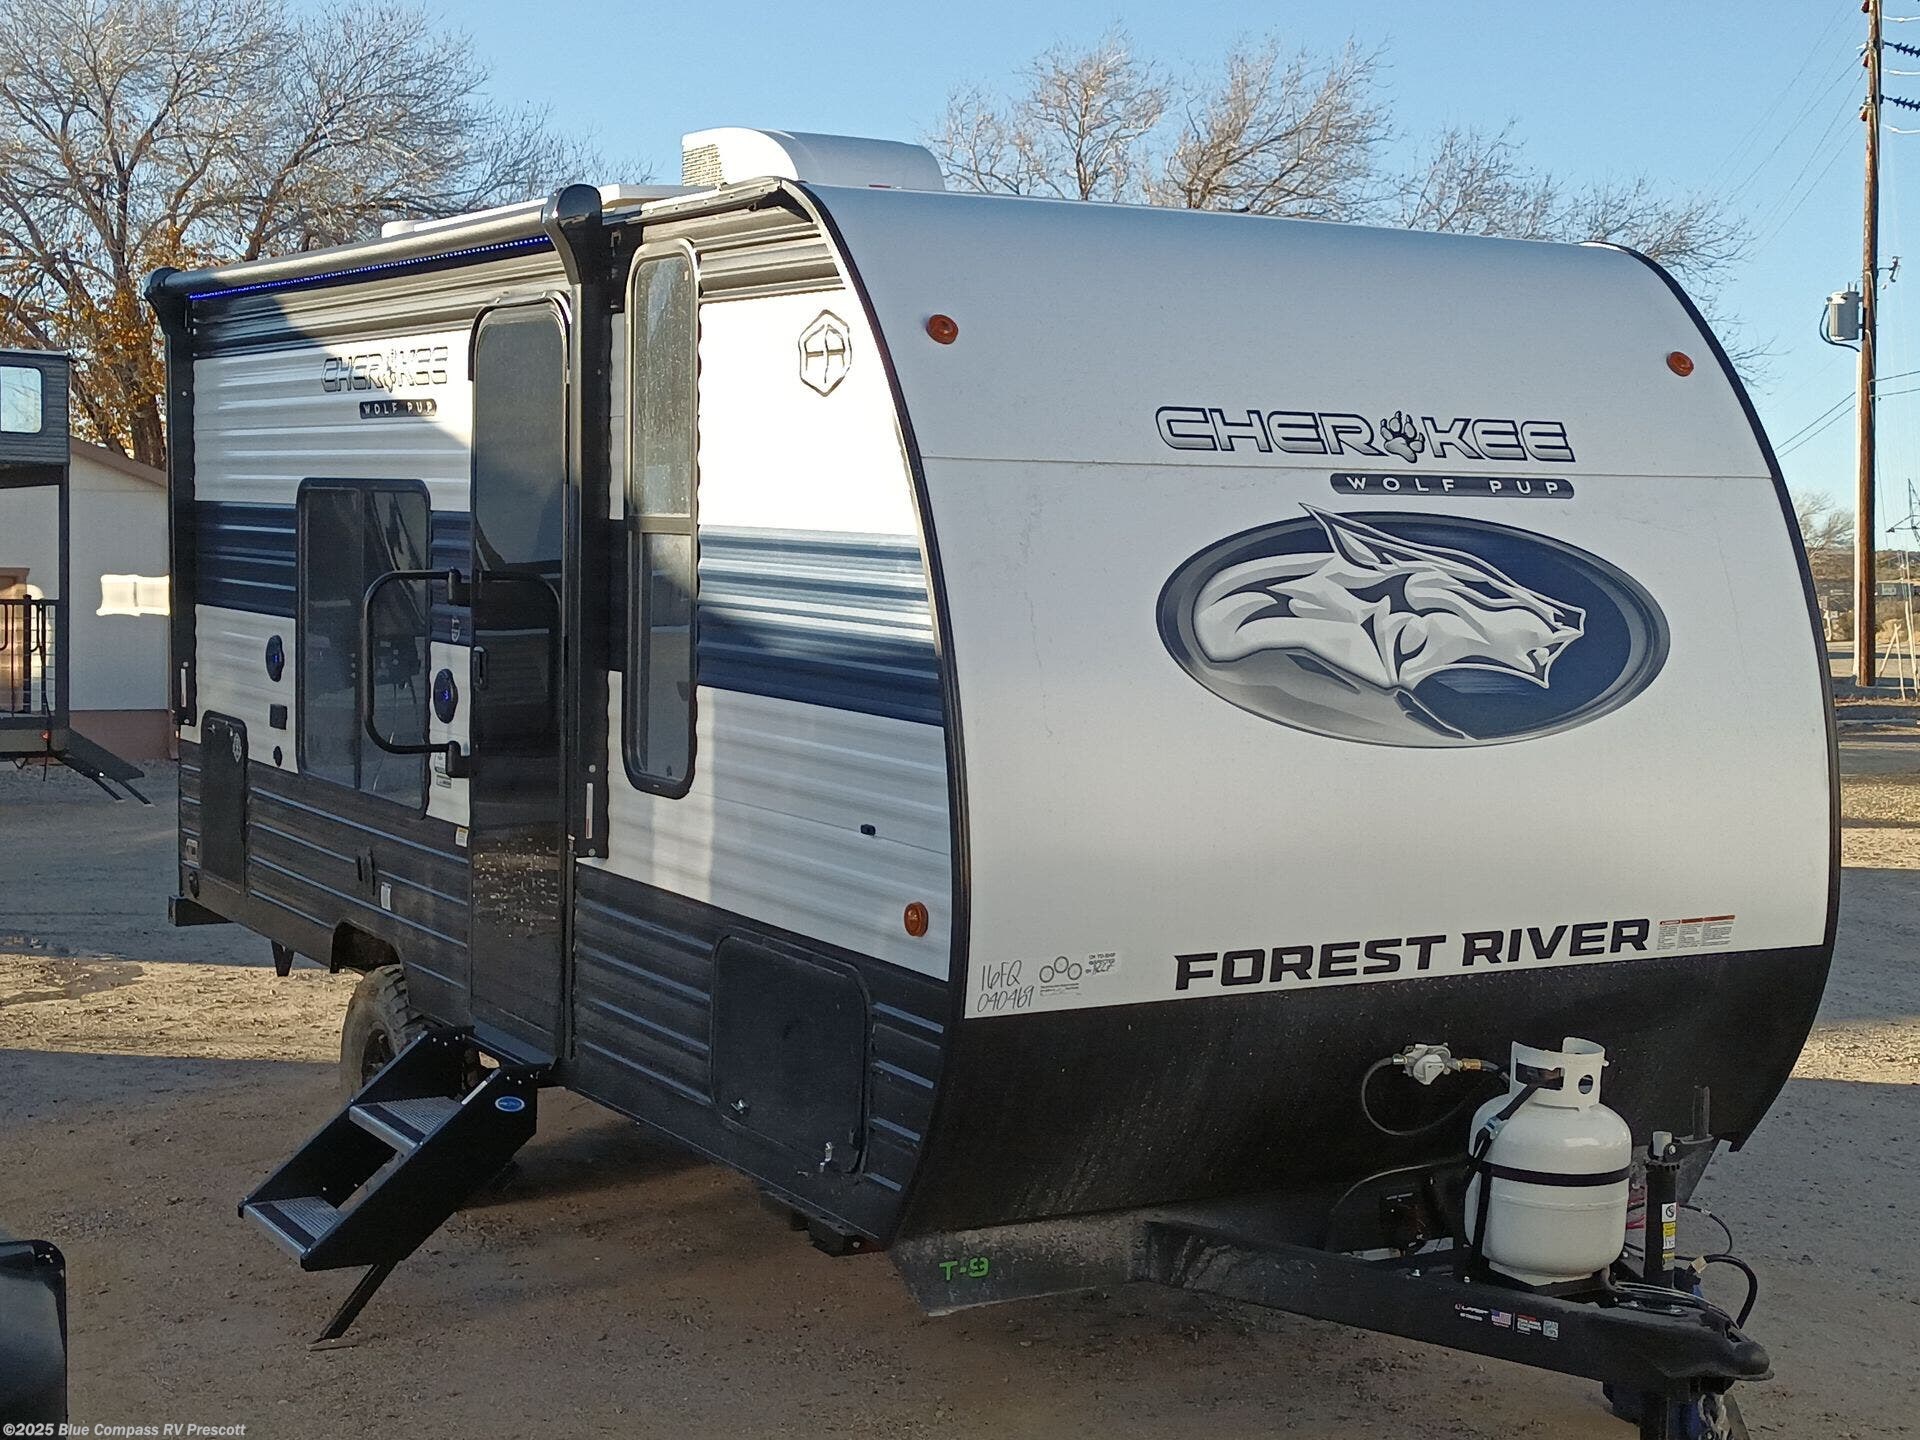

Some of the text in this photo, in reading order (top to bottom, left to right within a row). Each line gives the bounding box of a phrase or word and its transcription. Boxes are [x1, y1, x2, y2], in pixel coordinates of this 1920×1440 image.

[362, 401, 433, 415] WOLF PUP
[1346, 476, 1558, 495] WOLF PUP
[1174, 934, 1447, 991] FOREST
[1461, 918, 1650, 967] RIVER
